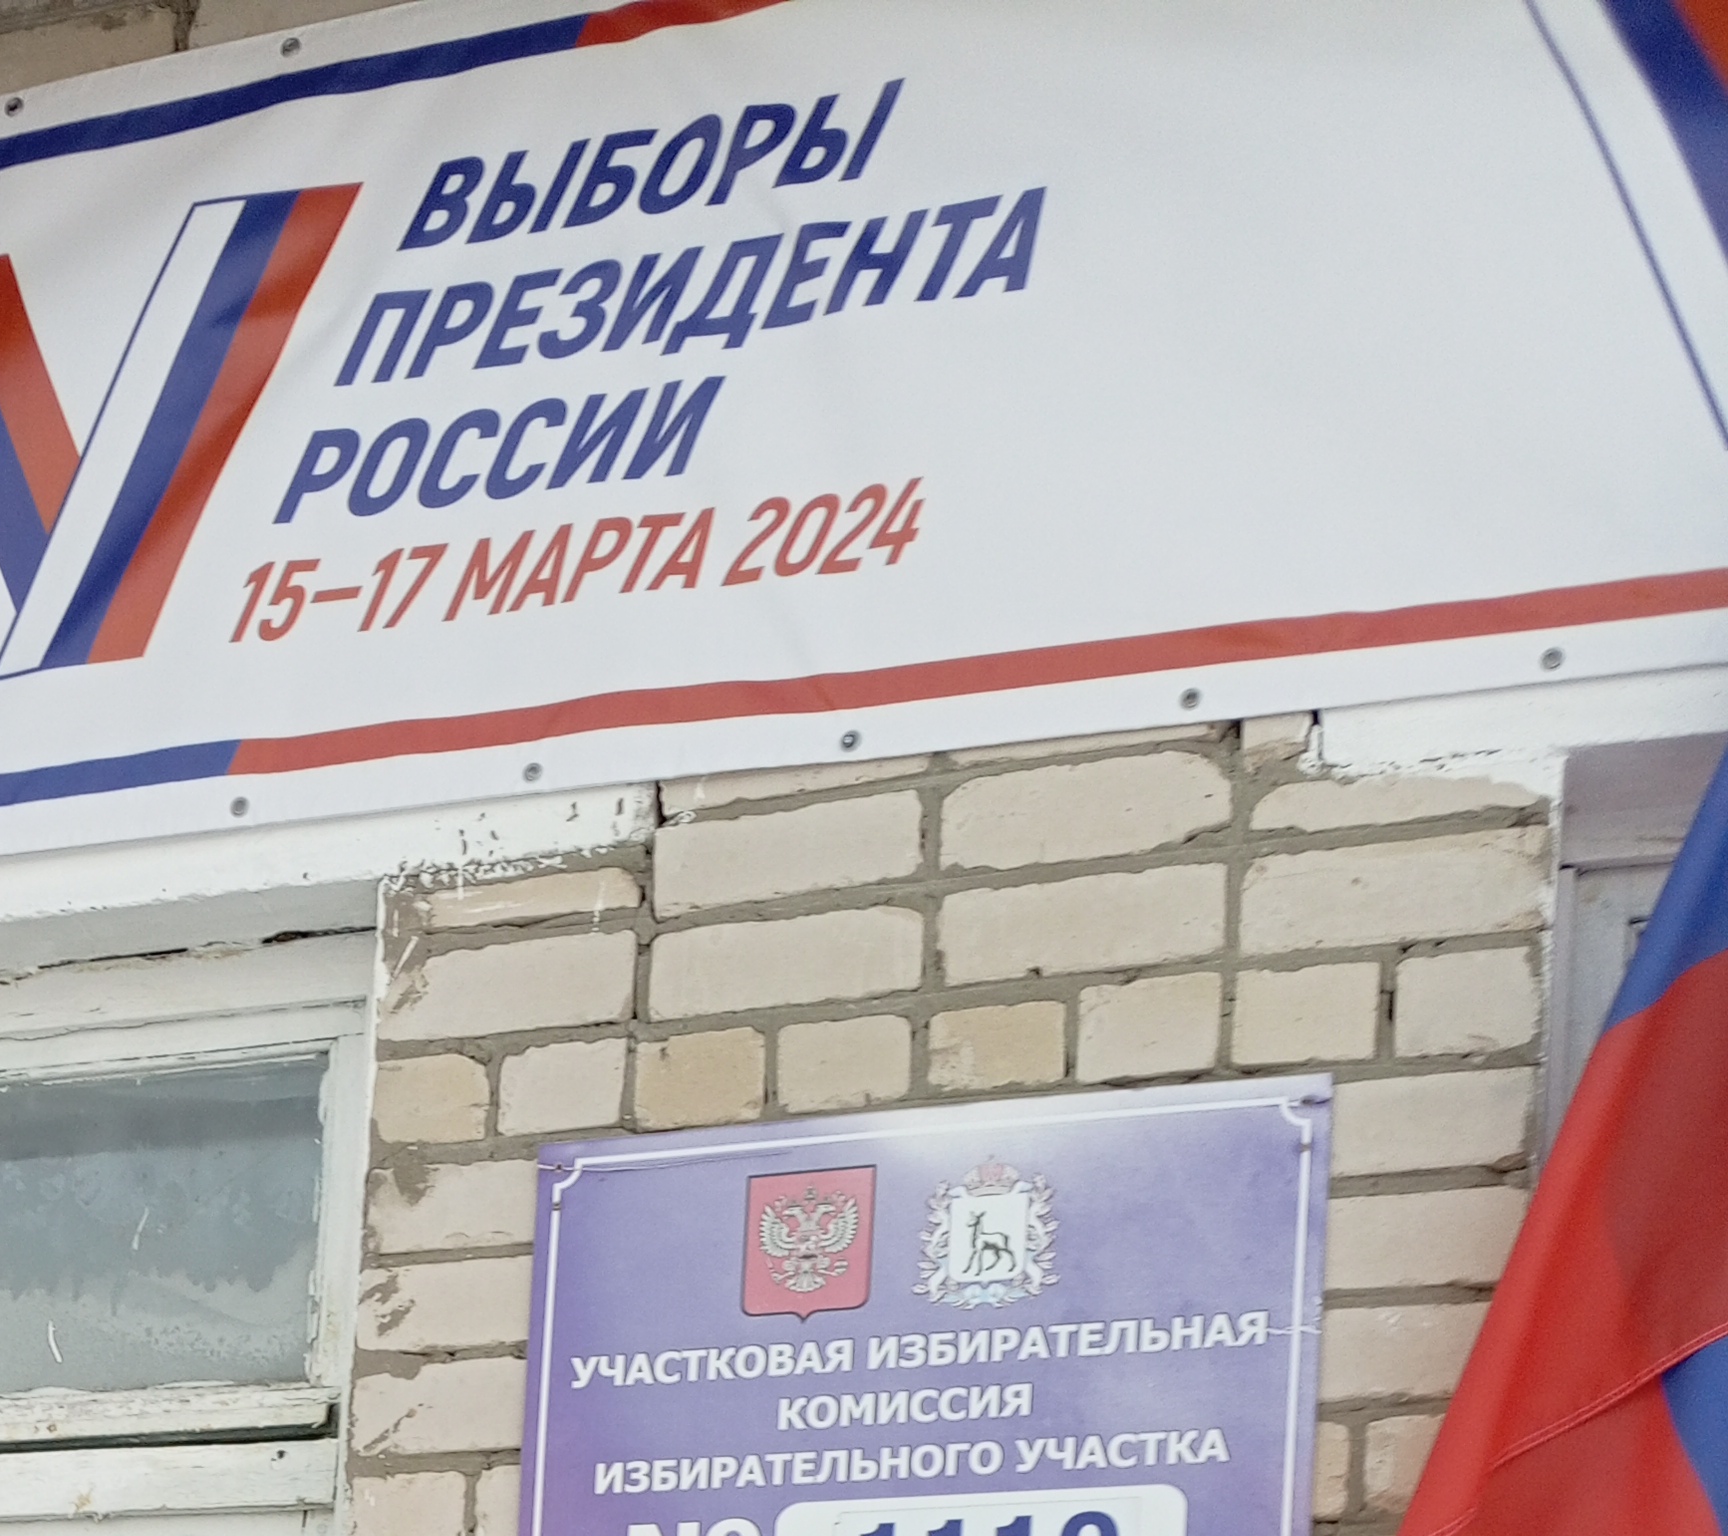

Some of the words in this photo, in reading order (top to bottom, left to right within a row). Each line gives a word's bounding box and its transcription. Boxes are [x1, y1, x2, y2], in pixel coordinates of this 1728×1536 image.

[396, 78, 906, 252] ВЫБОРЫ
[333, 186, 1047, 388] ПРЕЗИДЕНТА
[273, 375, 726, 525] РОССИИ
[443, 507, 717, 623] МАРТА
[720, 477, 924, 588] 2024
[570, 1337, 854, 1390] УЧАСТКОВАЯ
[867, 1310, 1271, 1371] ИЗБИРАТЕЛЬНАЯ
[776, 1383, 1034, 1432] КОМИССИЯ
[593, 1439, 1005, 1496] ИЗБИРАТЕЛЬНОГО
[1015, 1428, 1230, 1475] УЧАСТКА
